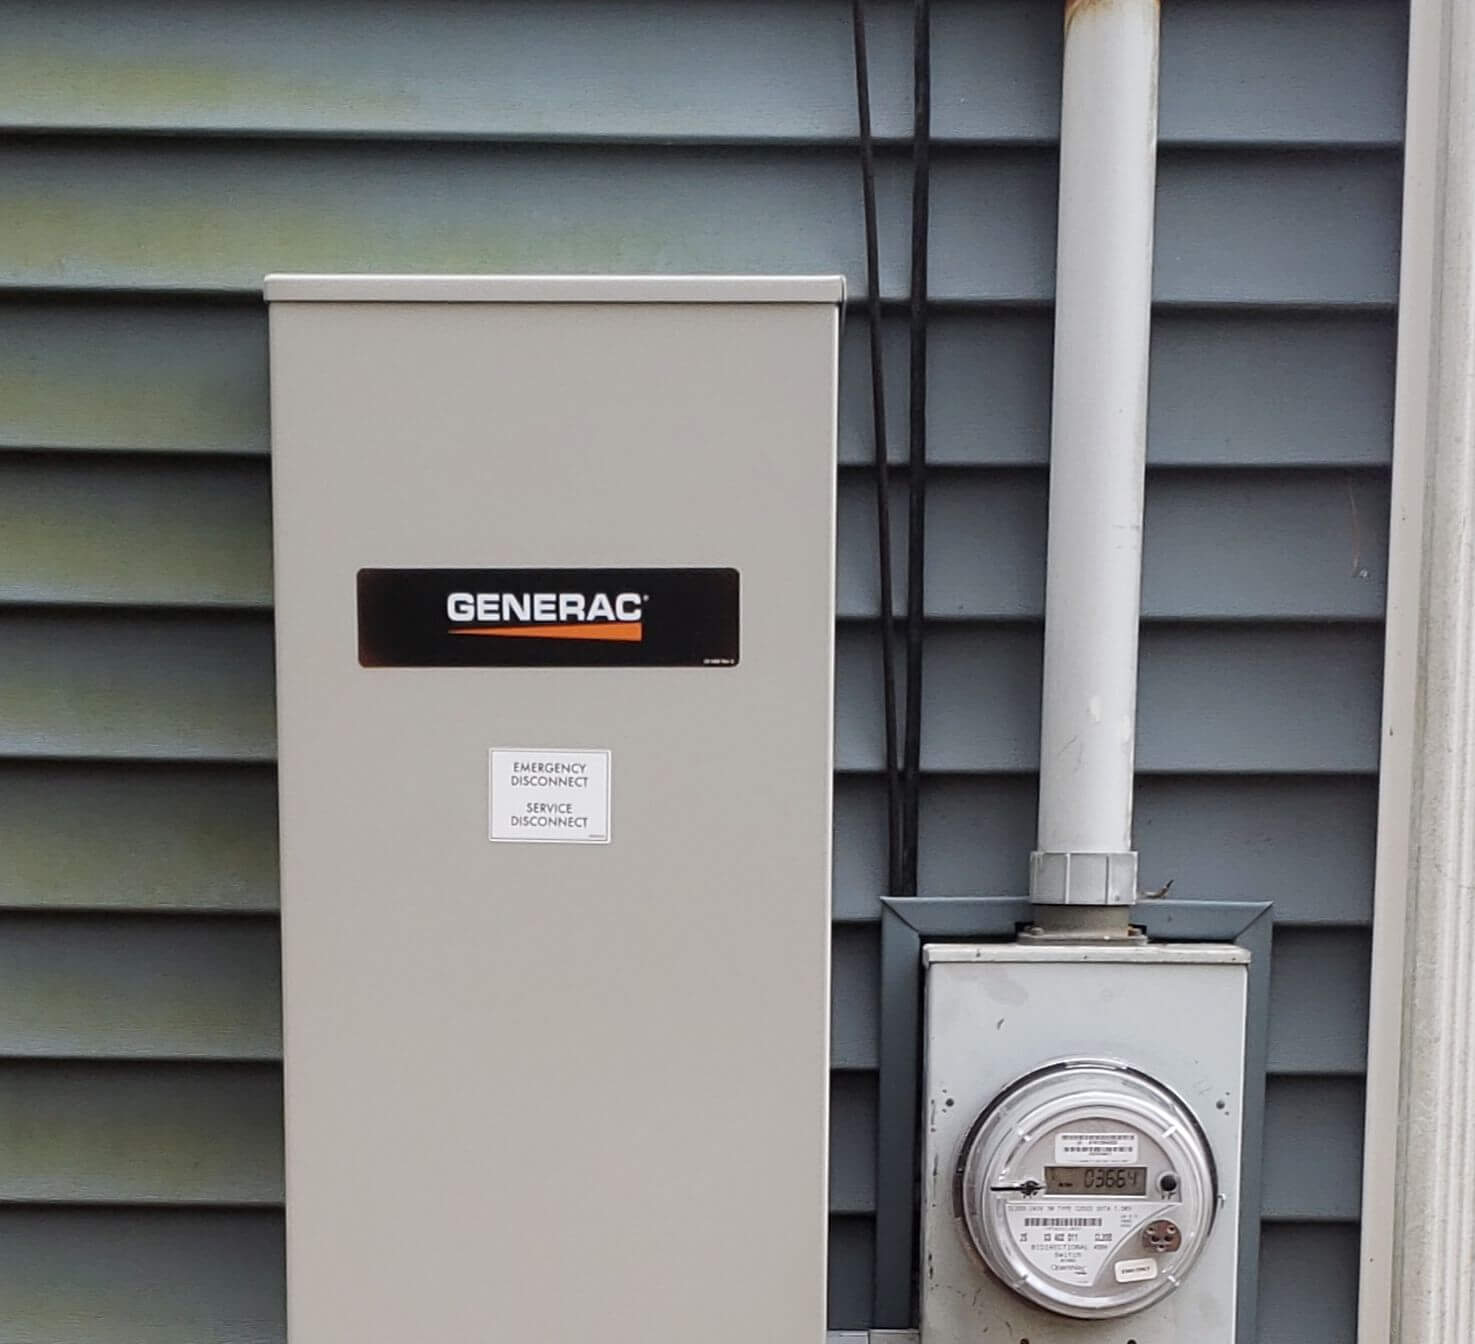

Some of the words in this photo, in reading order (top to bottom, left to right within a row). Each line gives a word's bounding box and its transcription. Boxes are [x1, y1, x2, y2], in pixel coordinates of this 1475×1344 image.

[447, 592, 642, 622] GENERAC
[513, 762, 587, 774] EMERGENCY
[511, 775, 588, 788] DISCONNECT
[526, 802, 573, 814] SERVICE
[511, 815, 588, 828] DISCONNECT
[1083, 1168, 1138, 1188] 03664
